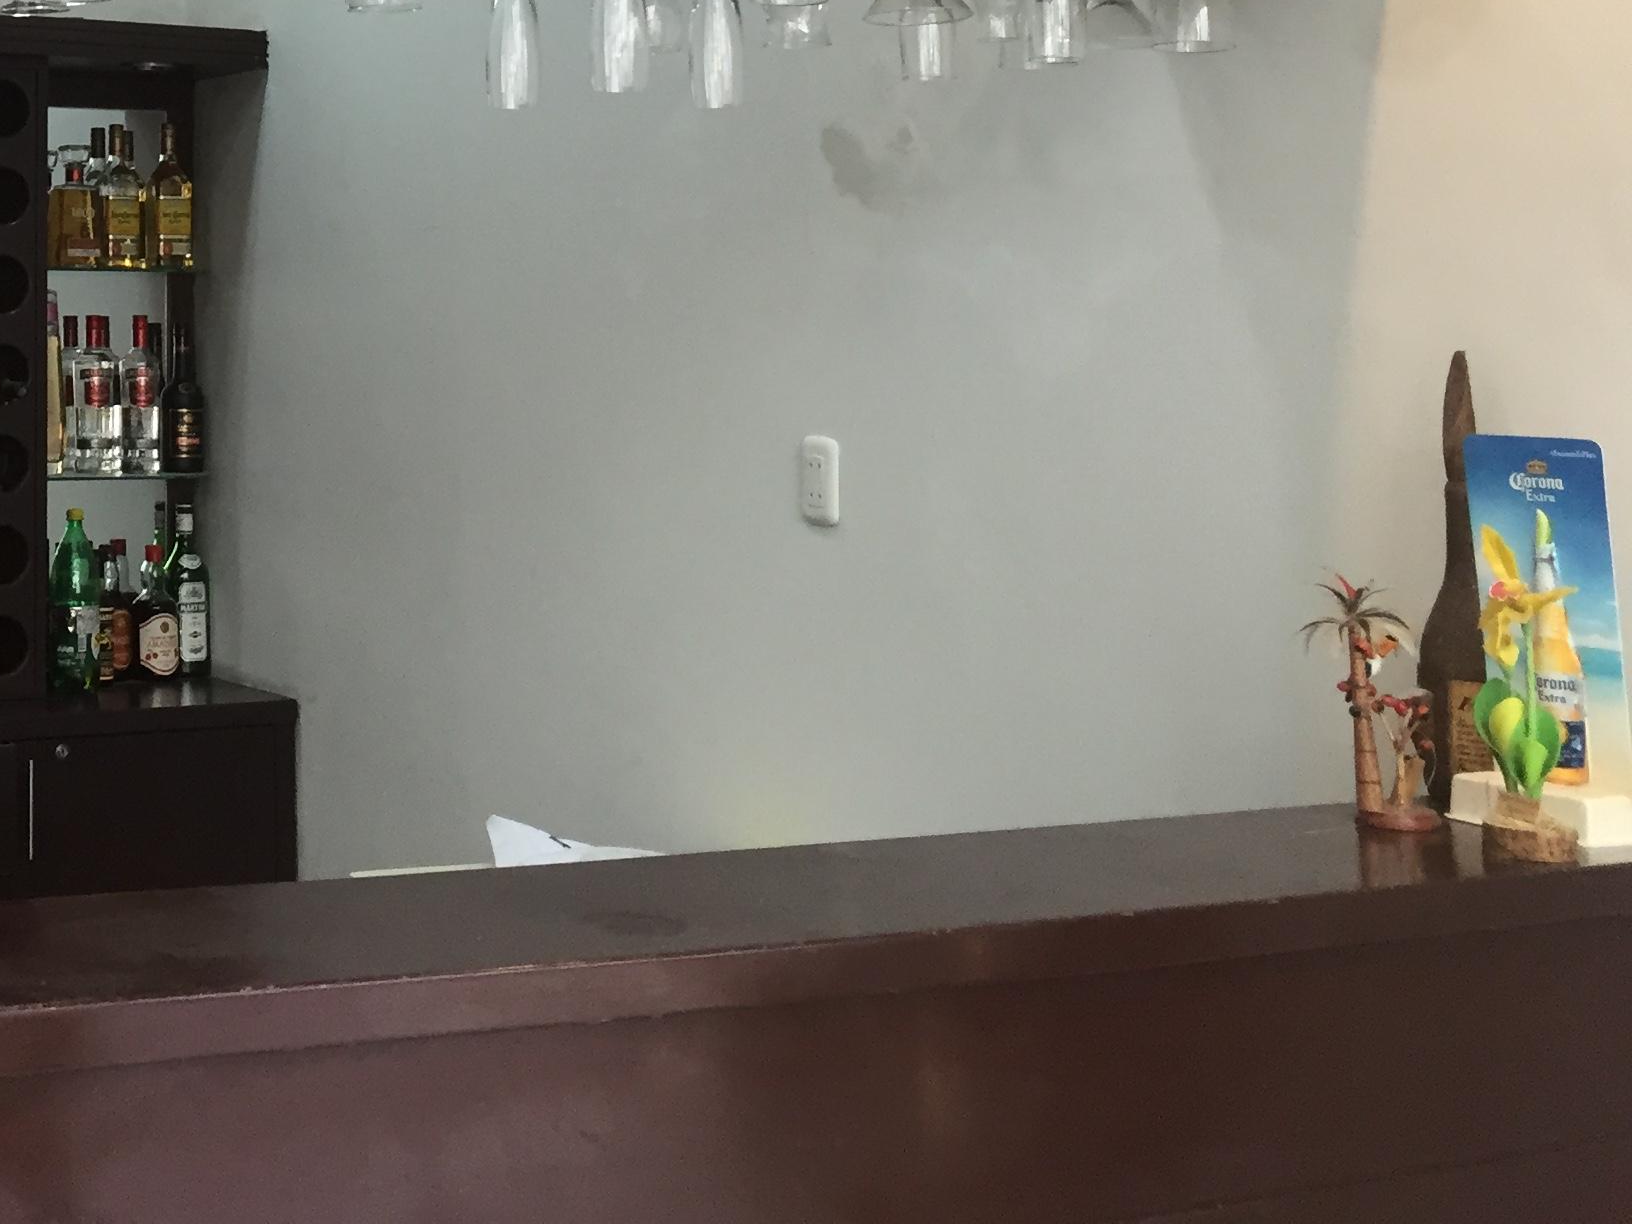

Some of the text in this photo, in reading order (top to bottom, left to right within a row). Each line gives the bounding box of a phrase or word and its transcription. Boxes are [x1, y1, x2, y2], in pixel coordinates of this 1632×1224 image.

[1509, 472, 1565, 492] Corona
[1526, 489, 1556, 503] Extra
[1536, 676, 1578, 692] orona
[1538, 691, 1568, 704] Extra
